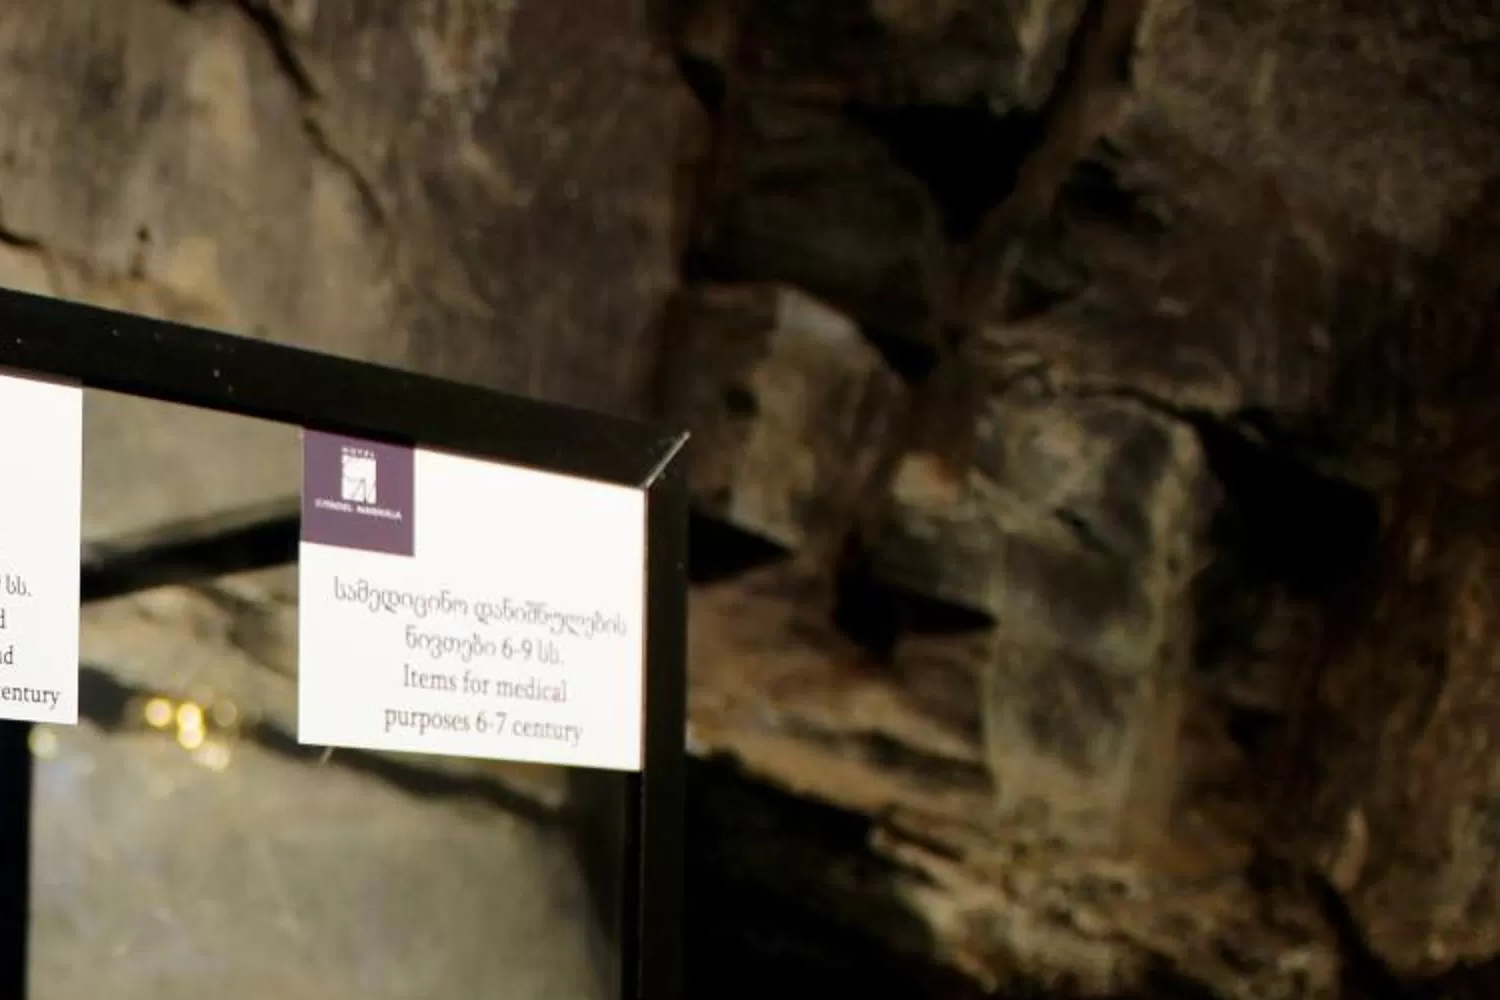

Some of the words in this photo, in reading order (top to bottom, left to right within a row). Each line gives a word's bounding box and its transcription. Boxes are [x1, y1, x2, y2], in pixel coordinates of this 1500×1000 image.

[501, 638, 532, 660] 6-9
[404, 664, 457, 692] Items
[462, 669, 490, 696] for
[496, 676, 567, 704] medical
[384, 708, 470, 736] purposes
[476, 712, 507, 733] 6-7
[512, 720, 582, 746] century
